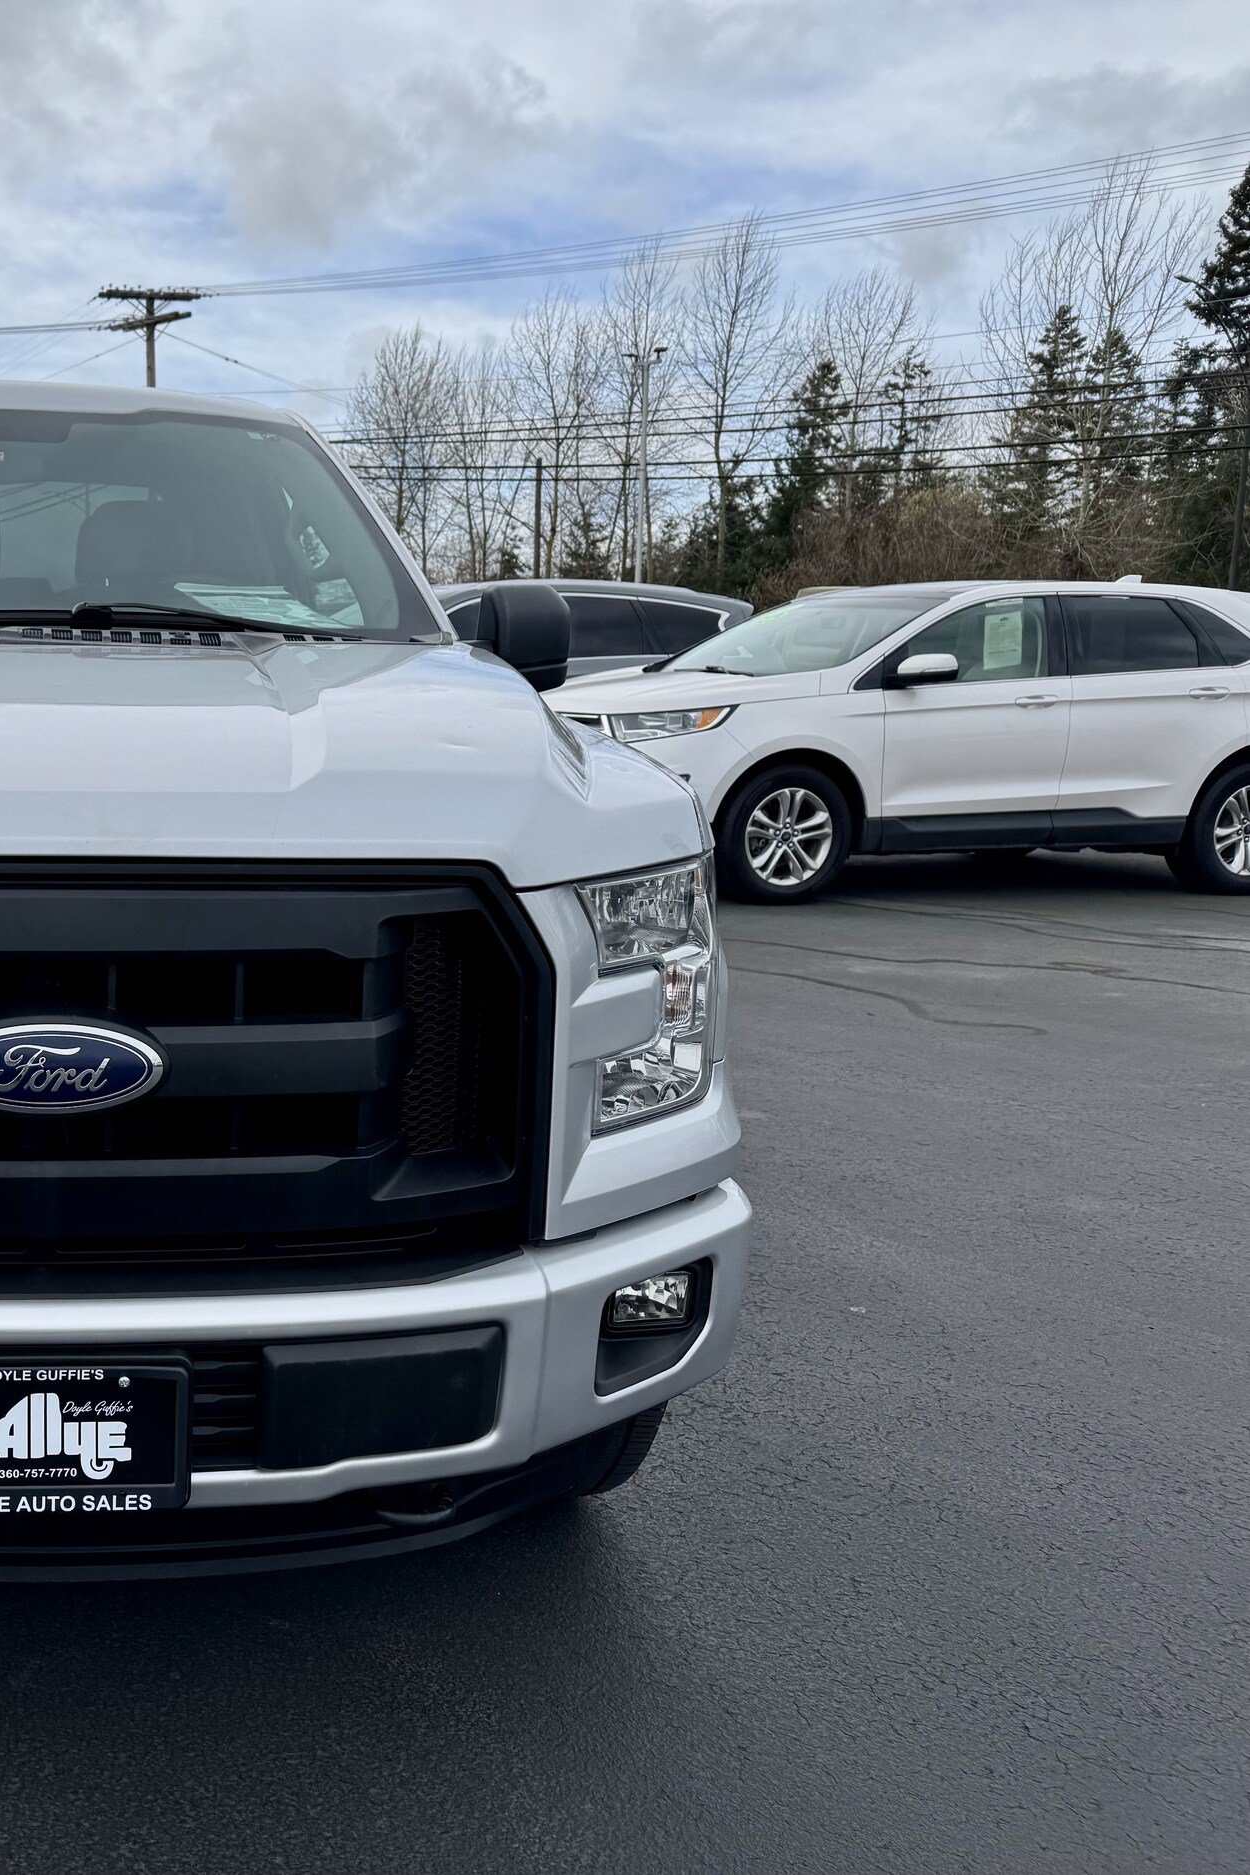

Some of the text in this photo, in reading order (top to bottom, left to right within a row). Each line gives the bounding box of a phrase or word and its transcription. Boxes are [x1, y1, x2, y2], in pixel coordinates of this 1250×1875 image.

[36, 1369, 104, 1381] GUFFIE'S
[62, 1400, 133, 1417] Doyle Guffie's
[16, 1496, 76, 1513] AUTO
[82, 1495, 152, 1512] SALES
